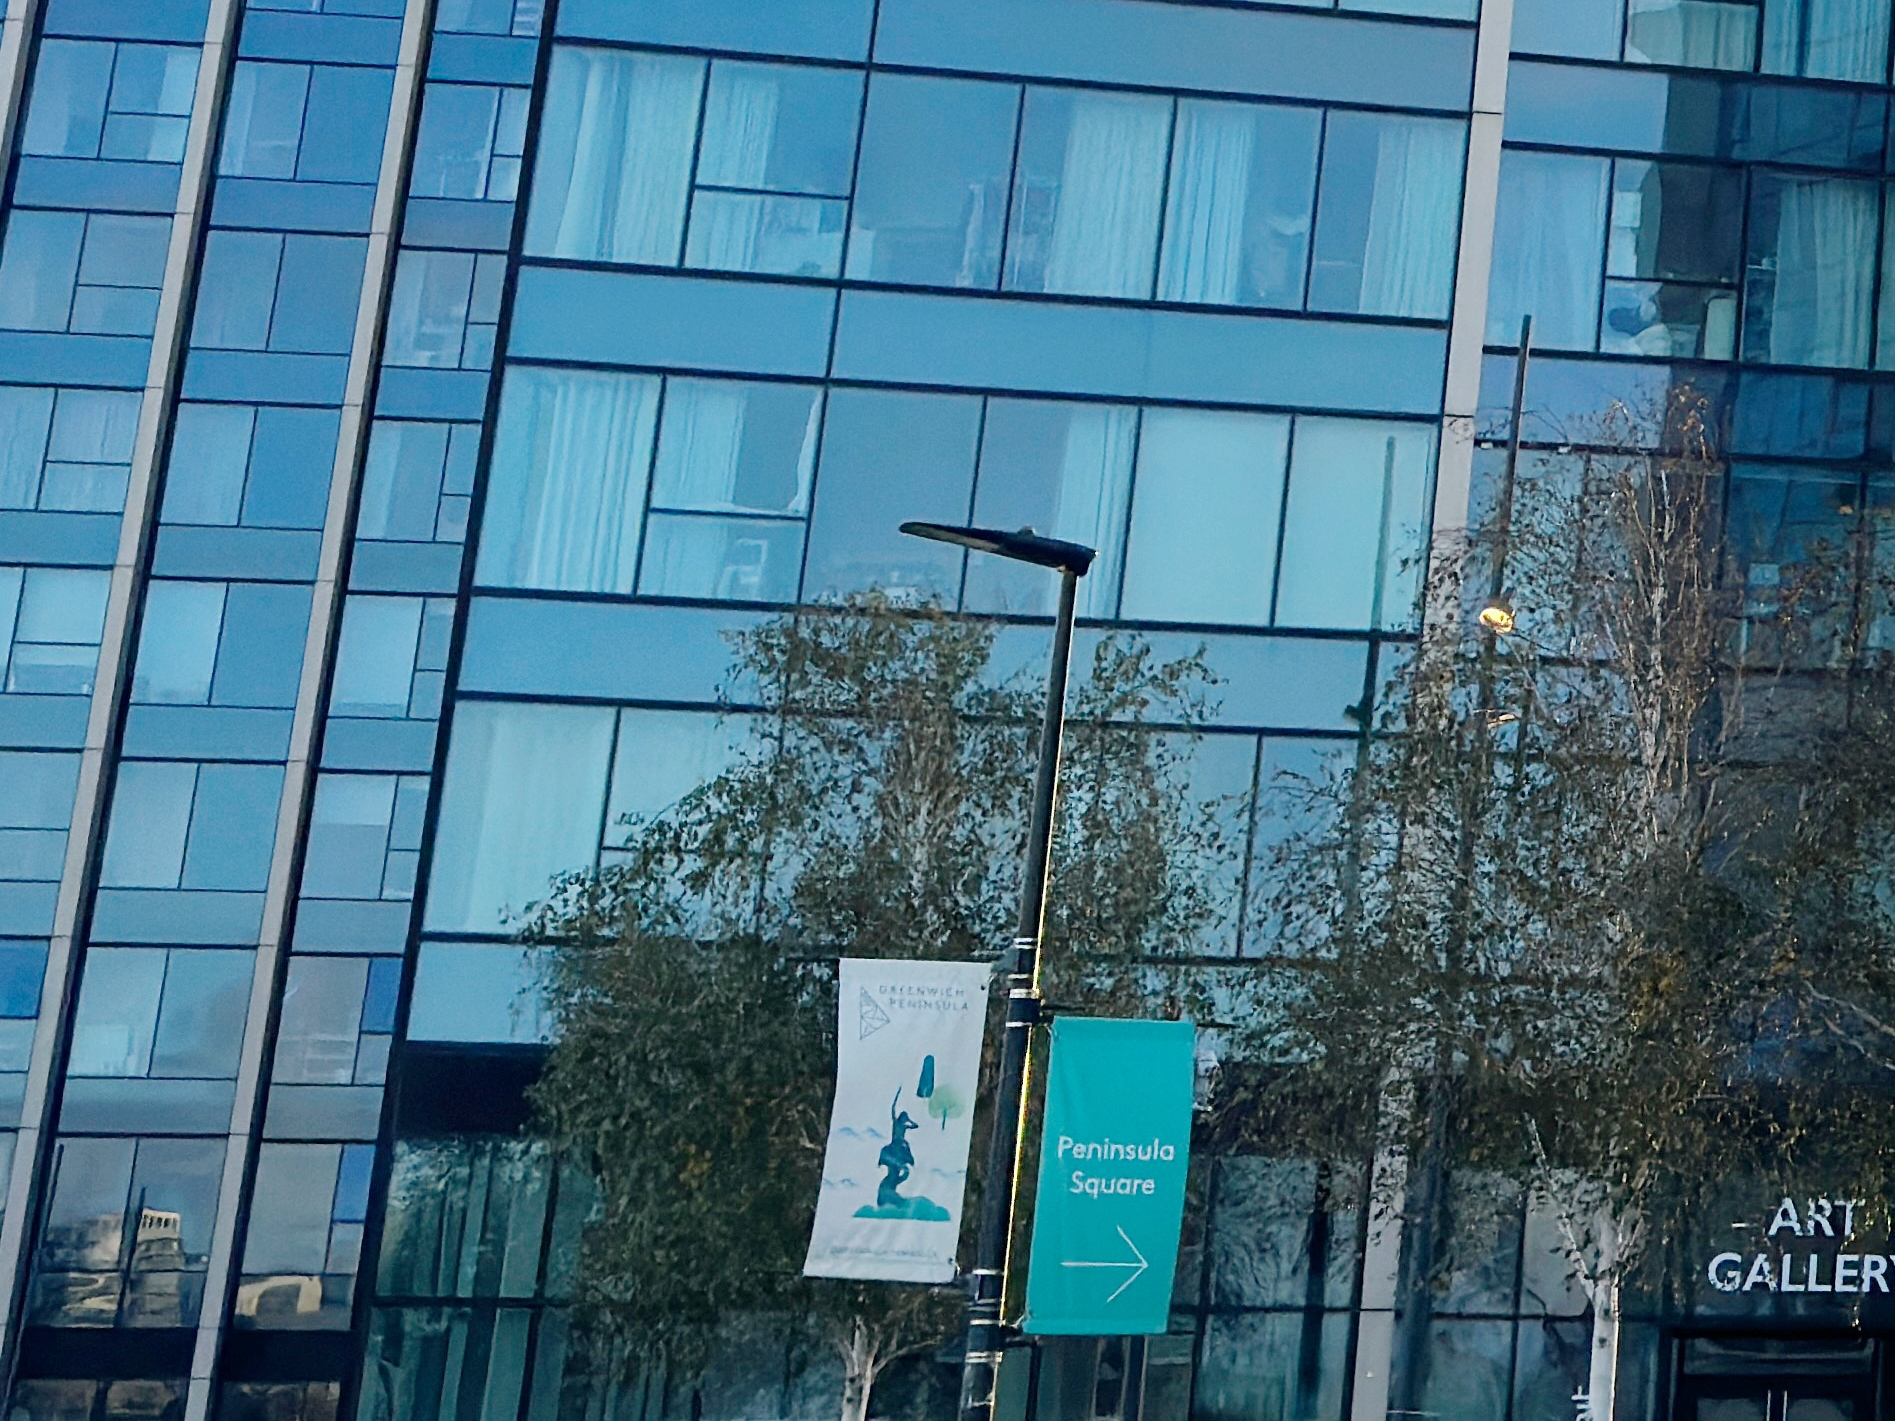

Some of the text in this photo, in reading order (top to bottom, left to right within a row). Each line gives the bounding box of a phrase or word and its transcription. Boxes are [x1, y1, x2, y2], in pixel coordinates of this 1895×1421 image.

[889, 998, 969, 1011] PENINSULA
[1057, 1135, 1175, 1161] Peninsula
[1069, 1170, 1155, 1199] Square
[1767, 1196, 1865, 1237] ART
